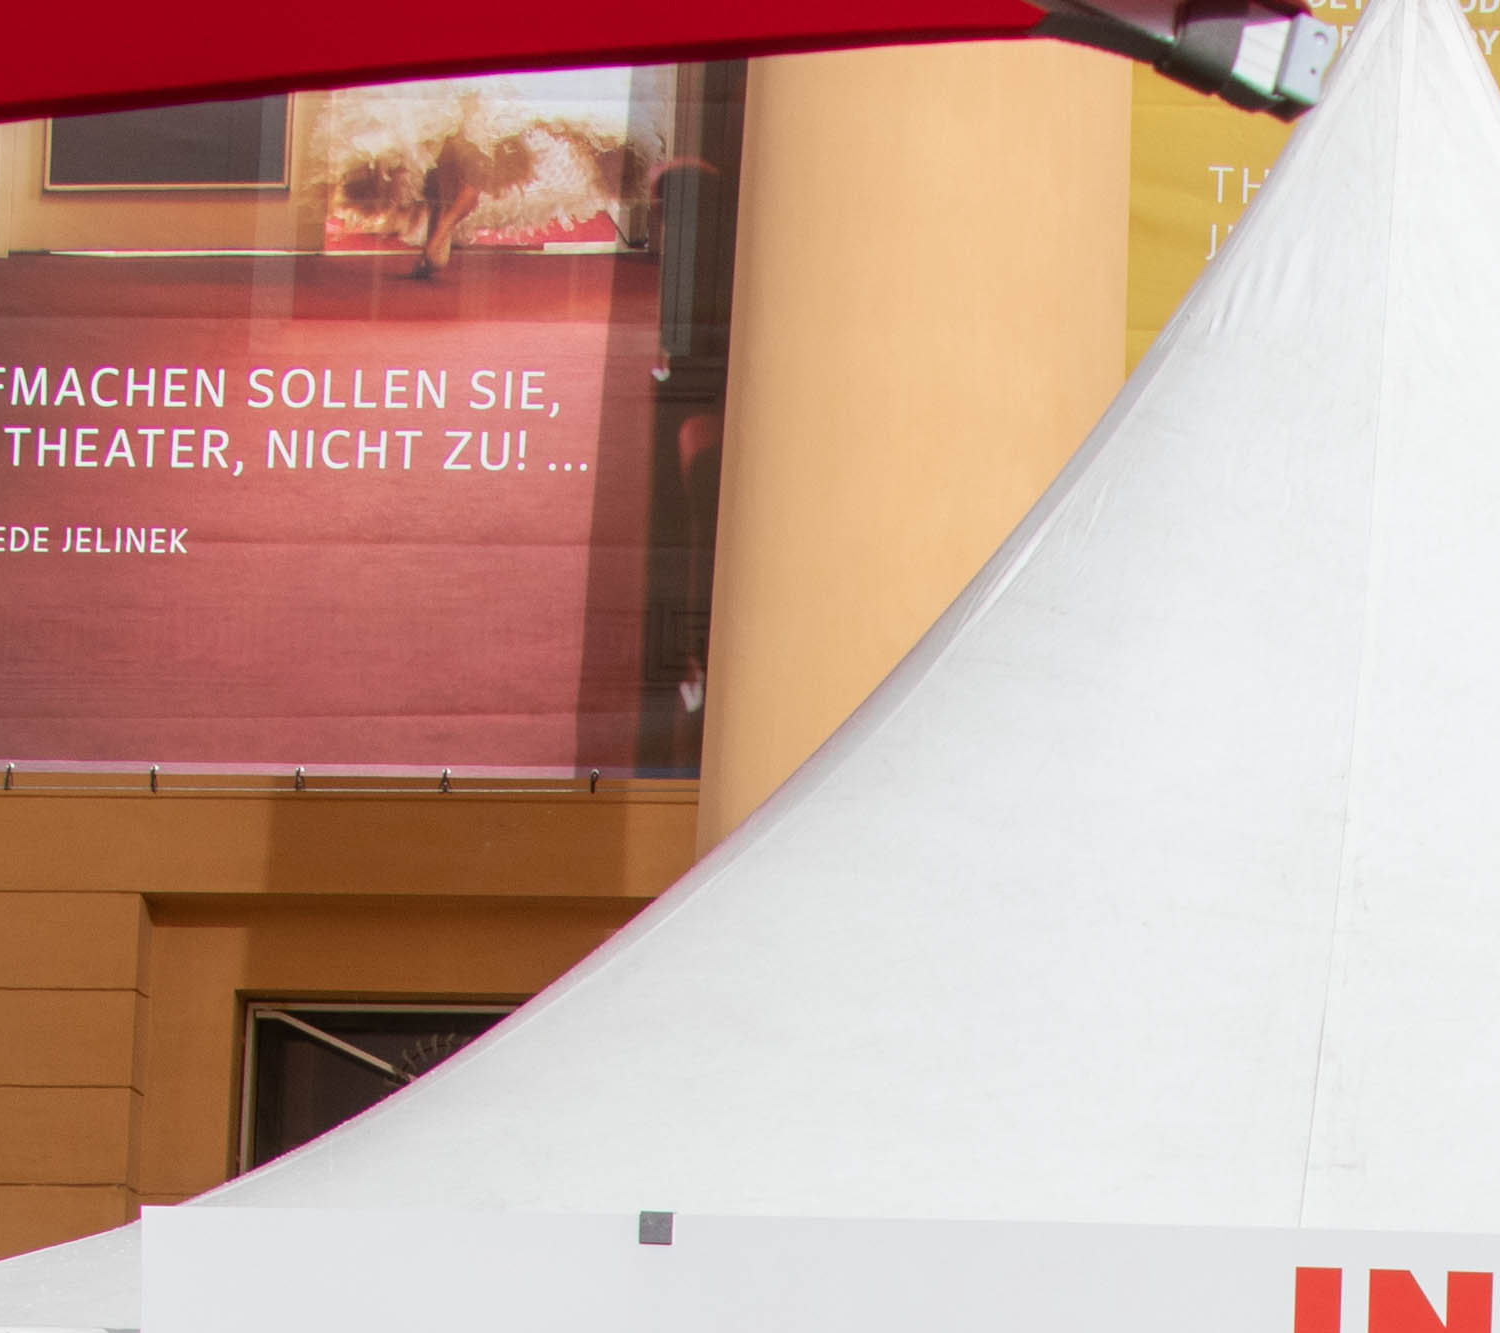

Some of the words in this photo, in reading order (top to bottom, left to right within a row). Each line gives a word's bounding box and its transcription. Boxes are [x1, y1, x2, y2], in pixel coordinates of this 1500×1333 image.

[246, 369, 447, 409] SOLLEN
[469, 371, 561, 419] SIE,
[4, 427, 244, 476] THEATER,
[266, 430, 423, 471] NICHT
[442, 431, 528, 472] ZU!
[62, 527, 189, 555] JELINEK
